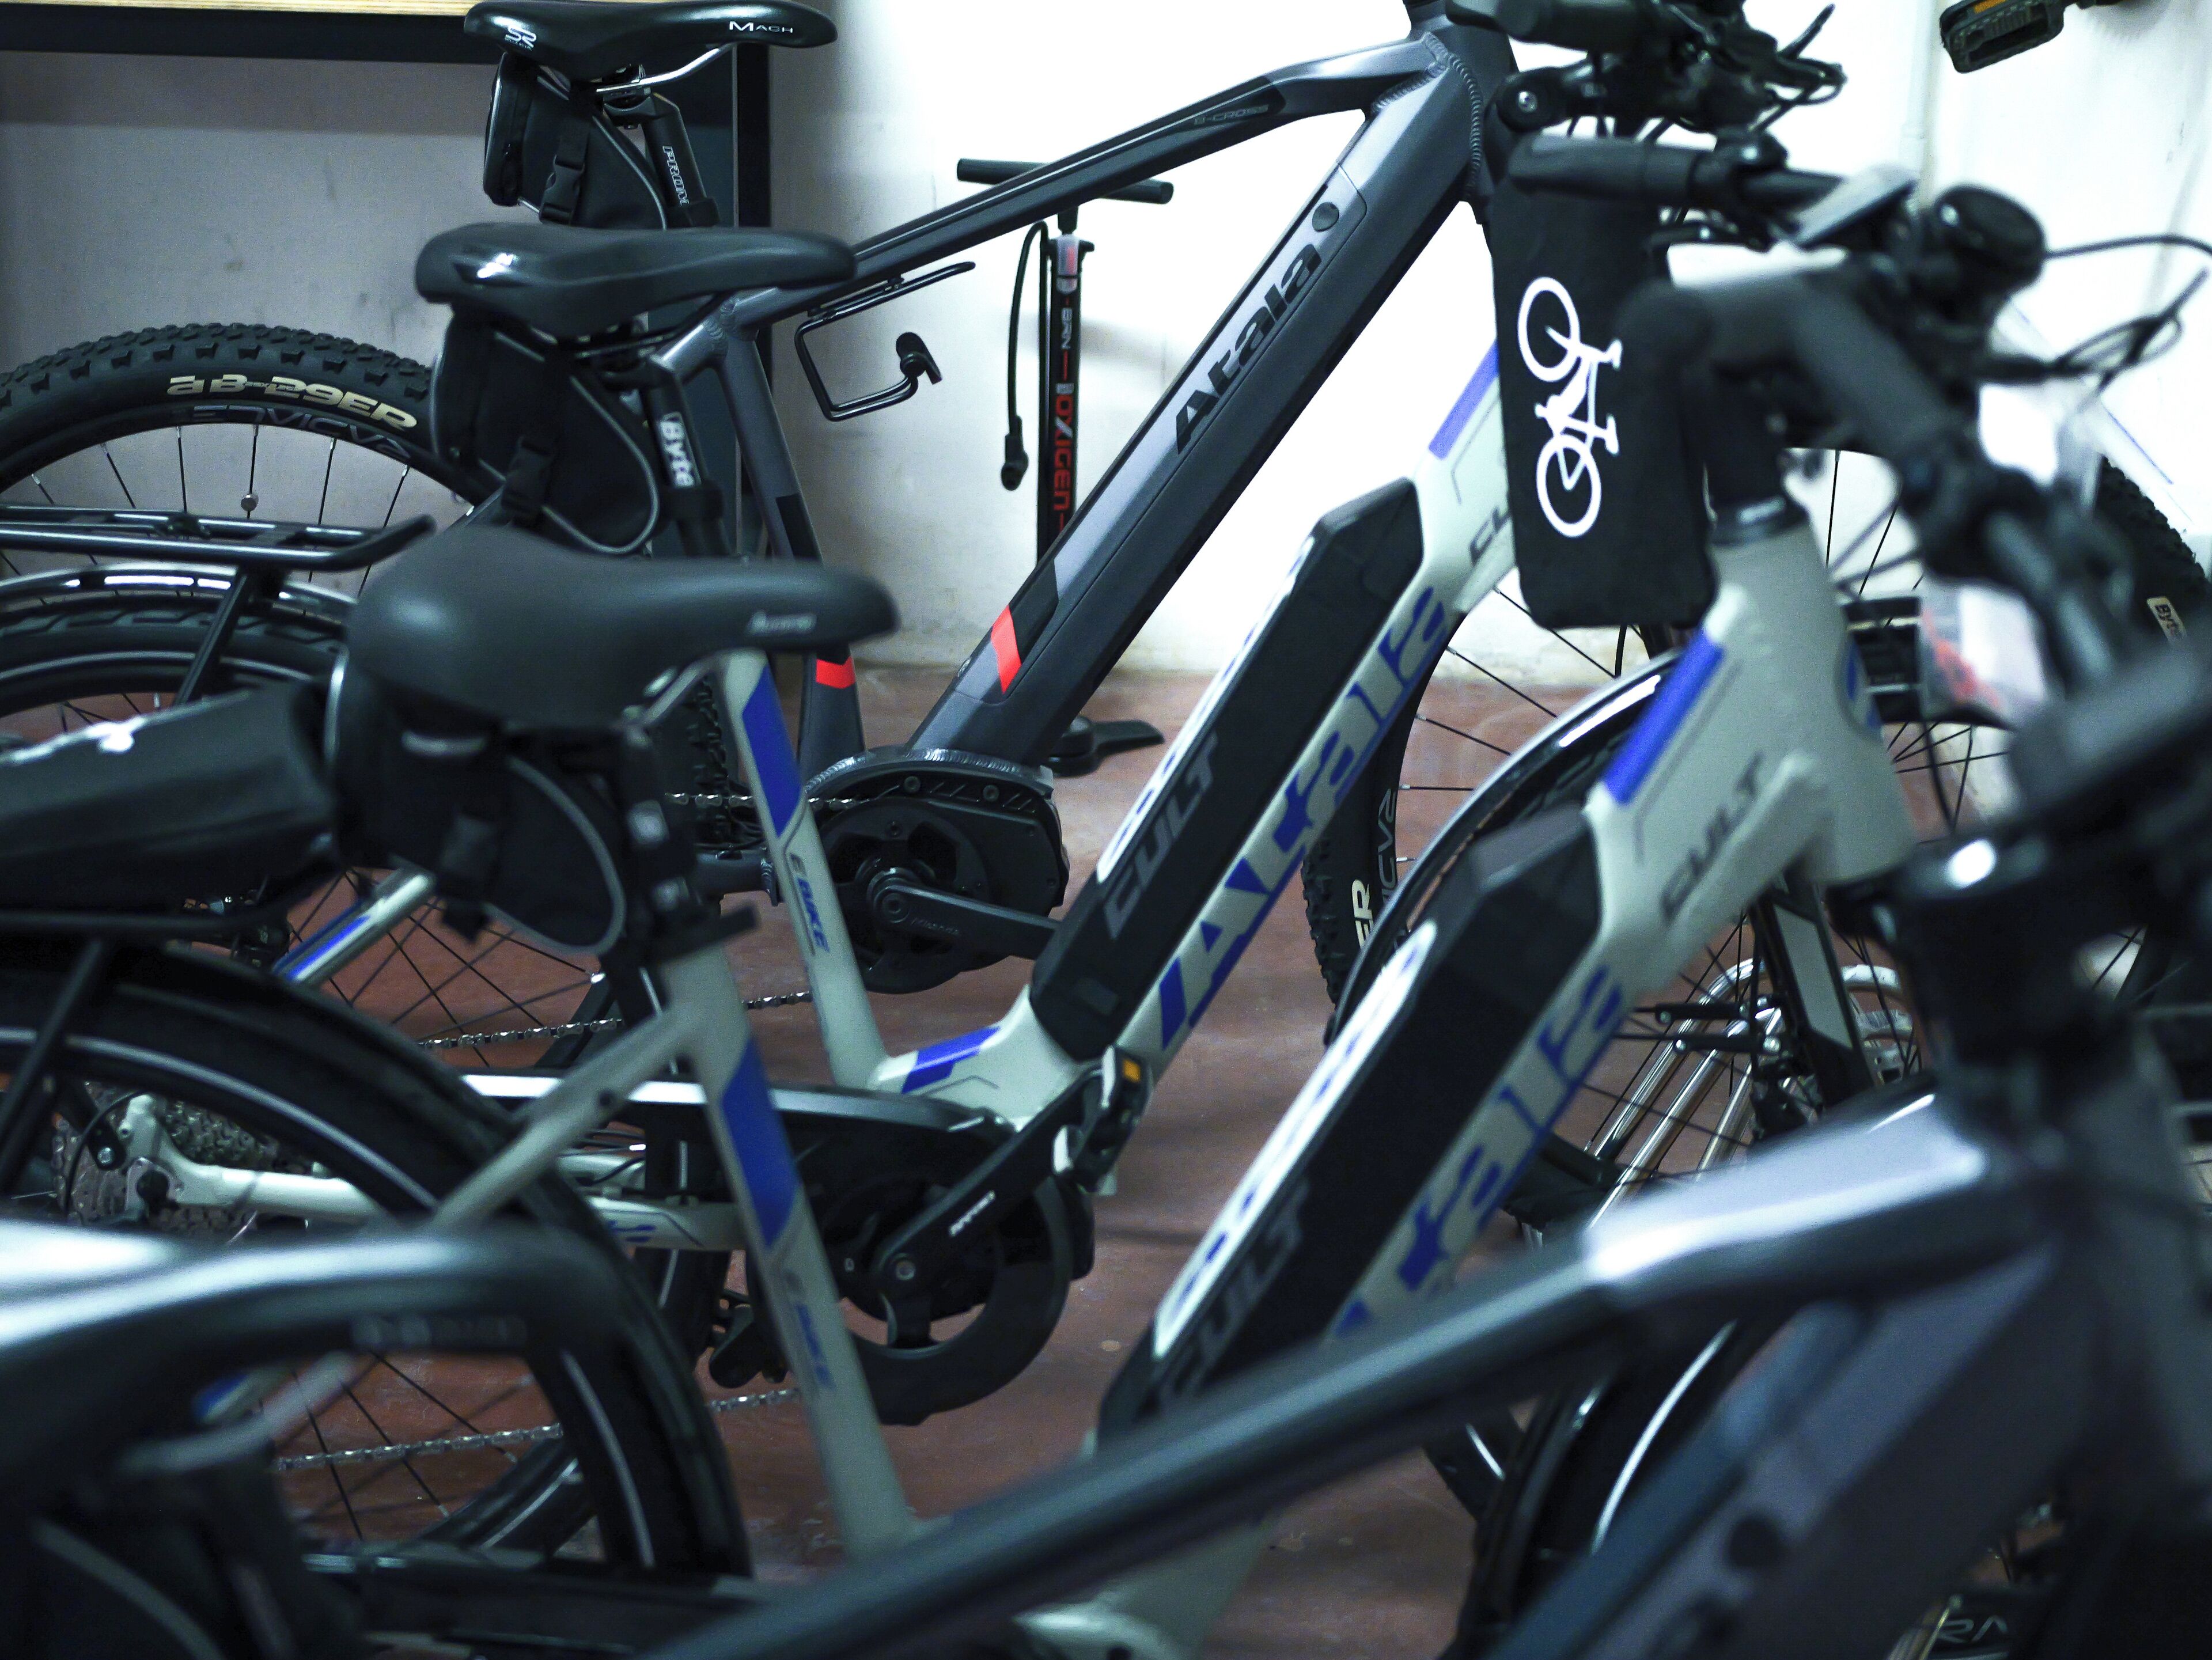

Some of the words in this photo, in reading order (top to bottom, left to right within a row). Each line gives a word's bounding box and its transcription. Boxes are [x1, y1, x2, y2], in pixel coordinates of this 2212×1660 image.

[729, 20, 793, 33] MACH
[662, 145, 690, 206] PROM
[1176, 244, 1322, 455] Atala
[1103, 729, 1219, 941] CULT
